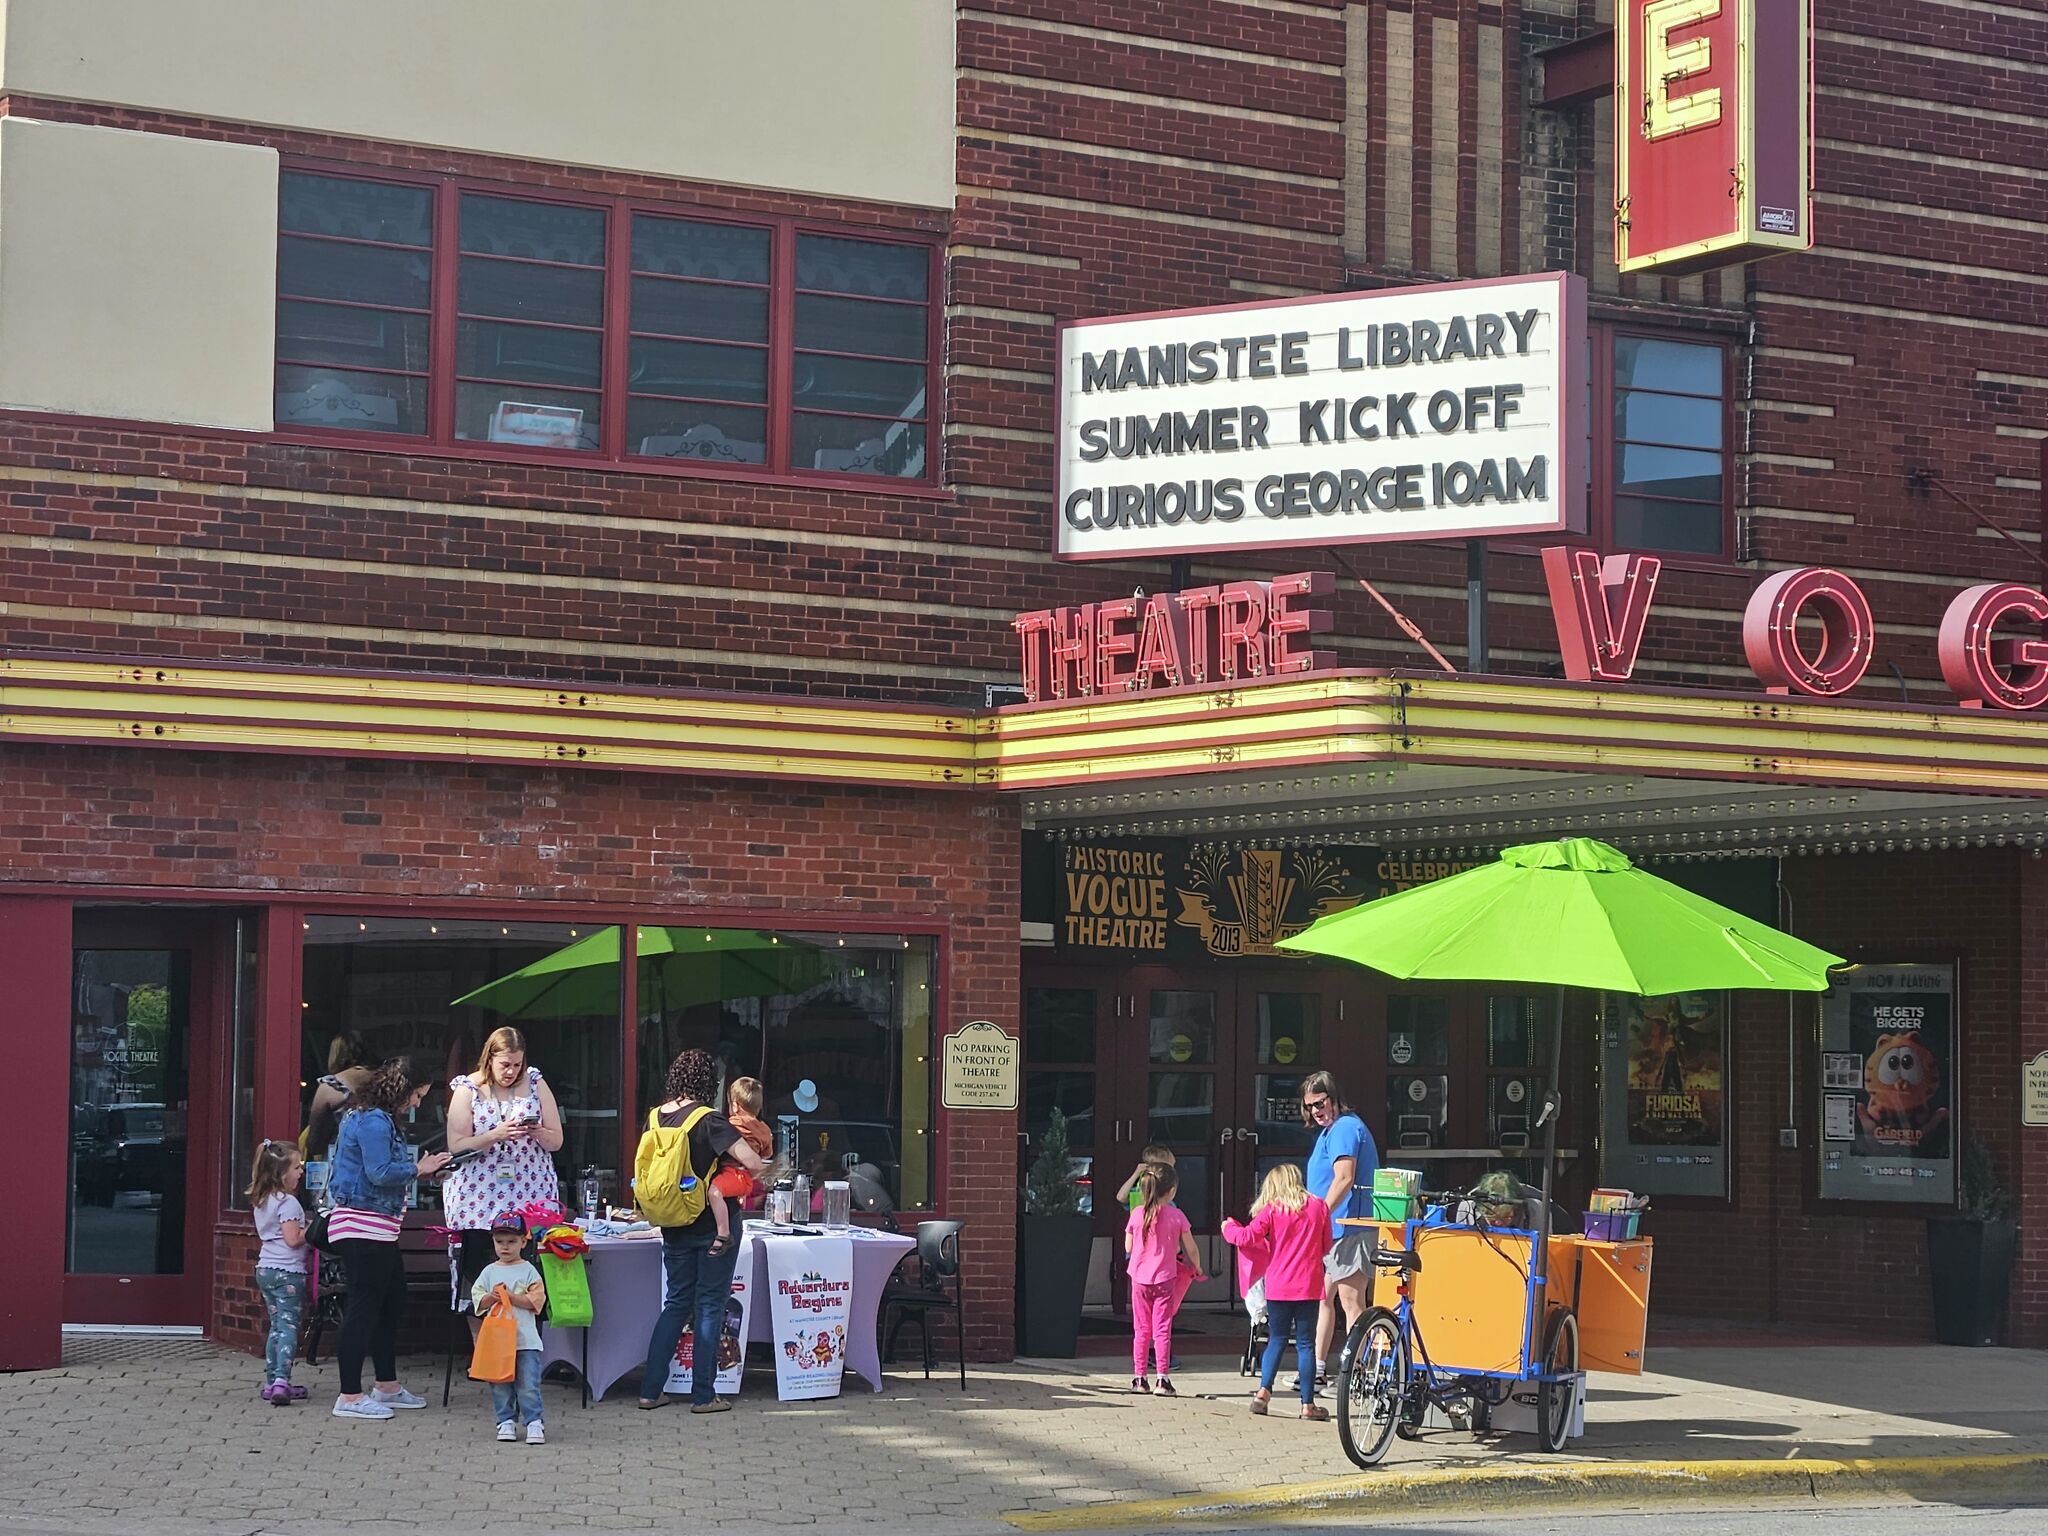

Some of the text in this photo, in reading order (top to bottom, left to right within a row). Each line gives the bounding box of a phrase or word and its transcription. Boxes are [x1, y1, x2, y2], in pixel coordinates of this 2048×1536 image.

[1641, 0, 1722, 143] E
[1081, 308, 1538, 393] MANISTEE LIBRARY
[1079, 405, 1269, 461] SUMMER
[1065, 478, 1244, 530] CURIOUS
[1255, 464, 1424, 519] GEORGE
[1015, 571, 1332, 703] THEATRE
[1074, 846, 1165, 876] HISTORIC
[1066, 872, 1168, 918] VOGUE
[1065, 915, 1167, 949] THEATRE
[1211, 923, 1240, 952] 2013
[1873, 1006, 1924, 1018] HE GETS
[1876, 1018, 1922, 1028] BIGGER
[131, 1051, 159, 1062] THEATRE
[953, 1043, 1010, 1054] NO PARKING
[952, 1055, 1011, 1066] IN FRONT OF
[962, 1067, 1000, 1077] THEATRE
[2030, 1070, 2041, 1078] NO
[1646, 1095, 1702, 1112] FURIOSA
[1873, 1126, 1922, 1140] GARFIELD
[778, 1278, 850, 1295] Adventure
[791, 1294, 842, 1313] Begins
